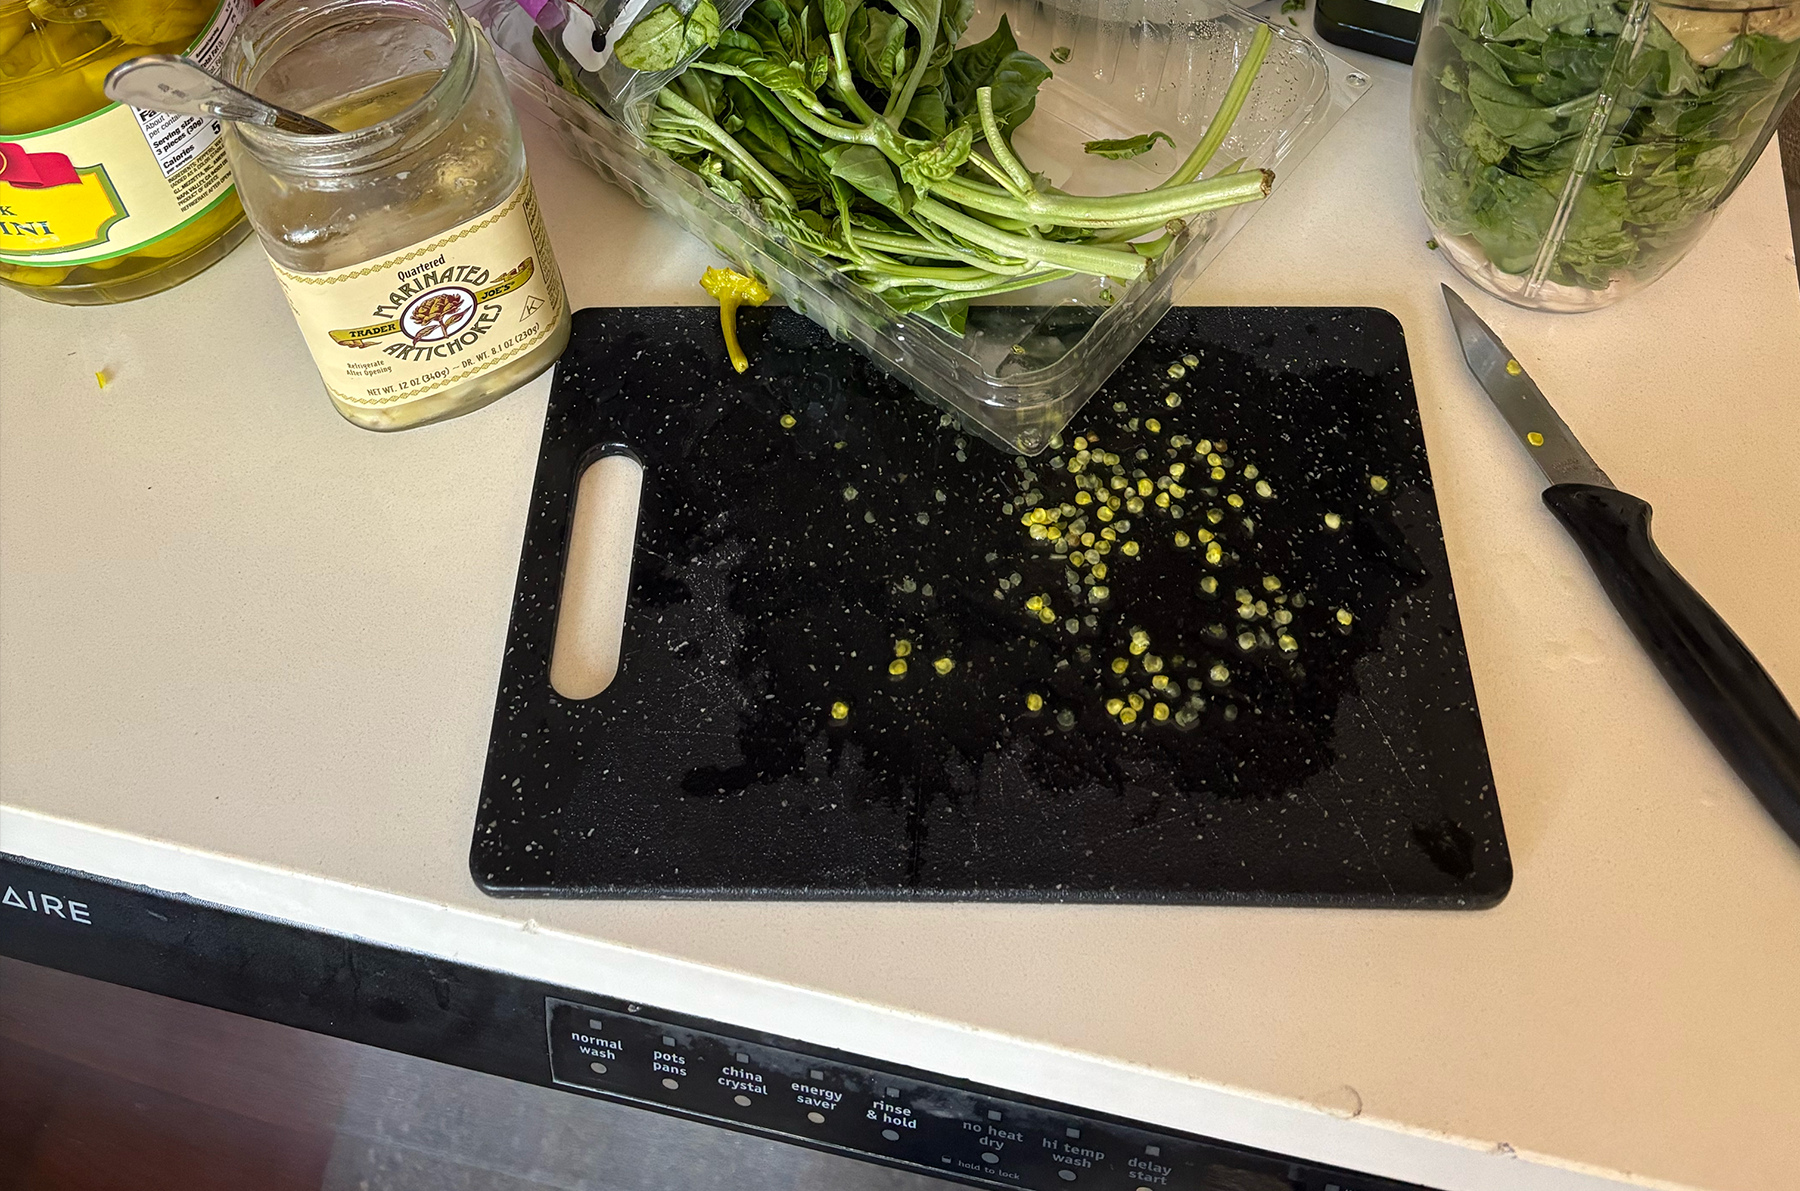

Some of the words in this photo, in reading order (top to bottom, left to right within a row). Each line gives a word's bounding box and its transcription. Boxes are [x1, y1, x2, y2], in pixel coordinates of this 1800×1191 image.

[145, 114, 165, 131] About
[149, 129, 161, 139] per
[153, 128, 181, 148] Serving
[181, 116, 195, 130] size
[163, 133, 186, 152] pieces
[187, 117, 204, 135] (30g)
[163, 144, 195, 169] Calories
[0, 221, 54, 235] INI
[398, 254, 446, 282] Quartered
[373, 265, 490, 319] MARINATED
[349, 323, 396, 338] TRADER
[382, 304, 503, 362] ARTICHOKES
[346, 360, 385, 370] Refrigerate
[366, 388, 382, 396] NET
[382, 385, 397, 394] WT.
[399, 381, 409, 390] 12
[409, 377, 421, 386] OZ
[421, 368, 450, 384] (340g)
[461, 358, 476, 369] DR.
[475, 351, 490, 364] WT.
[491, 345, 503, 357] 8.1
[504, 338, 514, 349] OZ
[514, 322, 541, 344] (230g)
[363, 365, 393, 377] Opening
[571, 1031, 624, 1051] normal
[579, 1045, 616, 1060] wash
[653, 1050, 686, 1065] pots
[653, 1062, 687, 1077] pans
[722, 1066, 763, 1083] china
[718, 1076, 768, 1095] crystal
[791, 1082, 843, 1103] energy
[796, 1094, 837, 1111] saver
[873, 1100, 911, 1117] rinse
[866, 1109, 877, 1121] &
[883, 1112, 917, 1130] hold
[963, 1121, 982, 1133] no
[988, 1125, 1024, 1143] heat
[979, 1136, 1004, 1150] dry
[1042, 1137, 1058, 1150] hi
[1064, 1142, 1105, 1161] temp
[958, 1159, 981, 1172] hold
[984, 1165, 996, 1175] to
[998, 1168, 1020, 1180] lock
[1052, 1153, 1092, 1169] wash
[1127, 1157, 1172, 1177] delay
[1128, 1169, 1167, 1185] start
